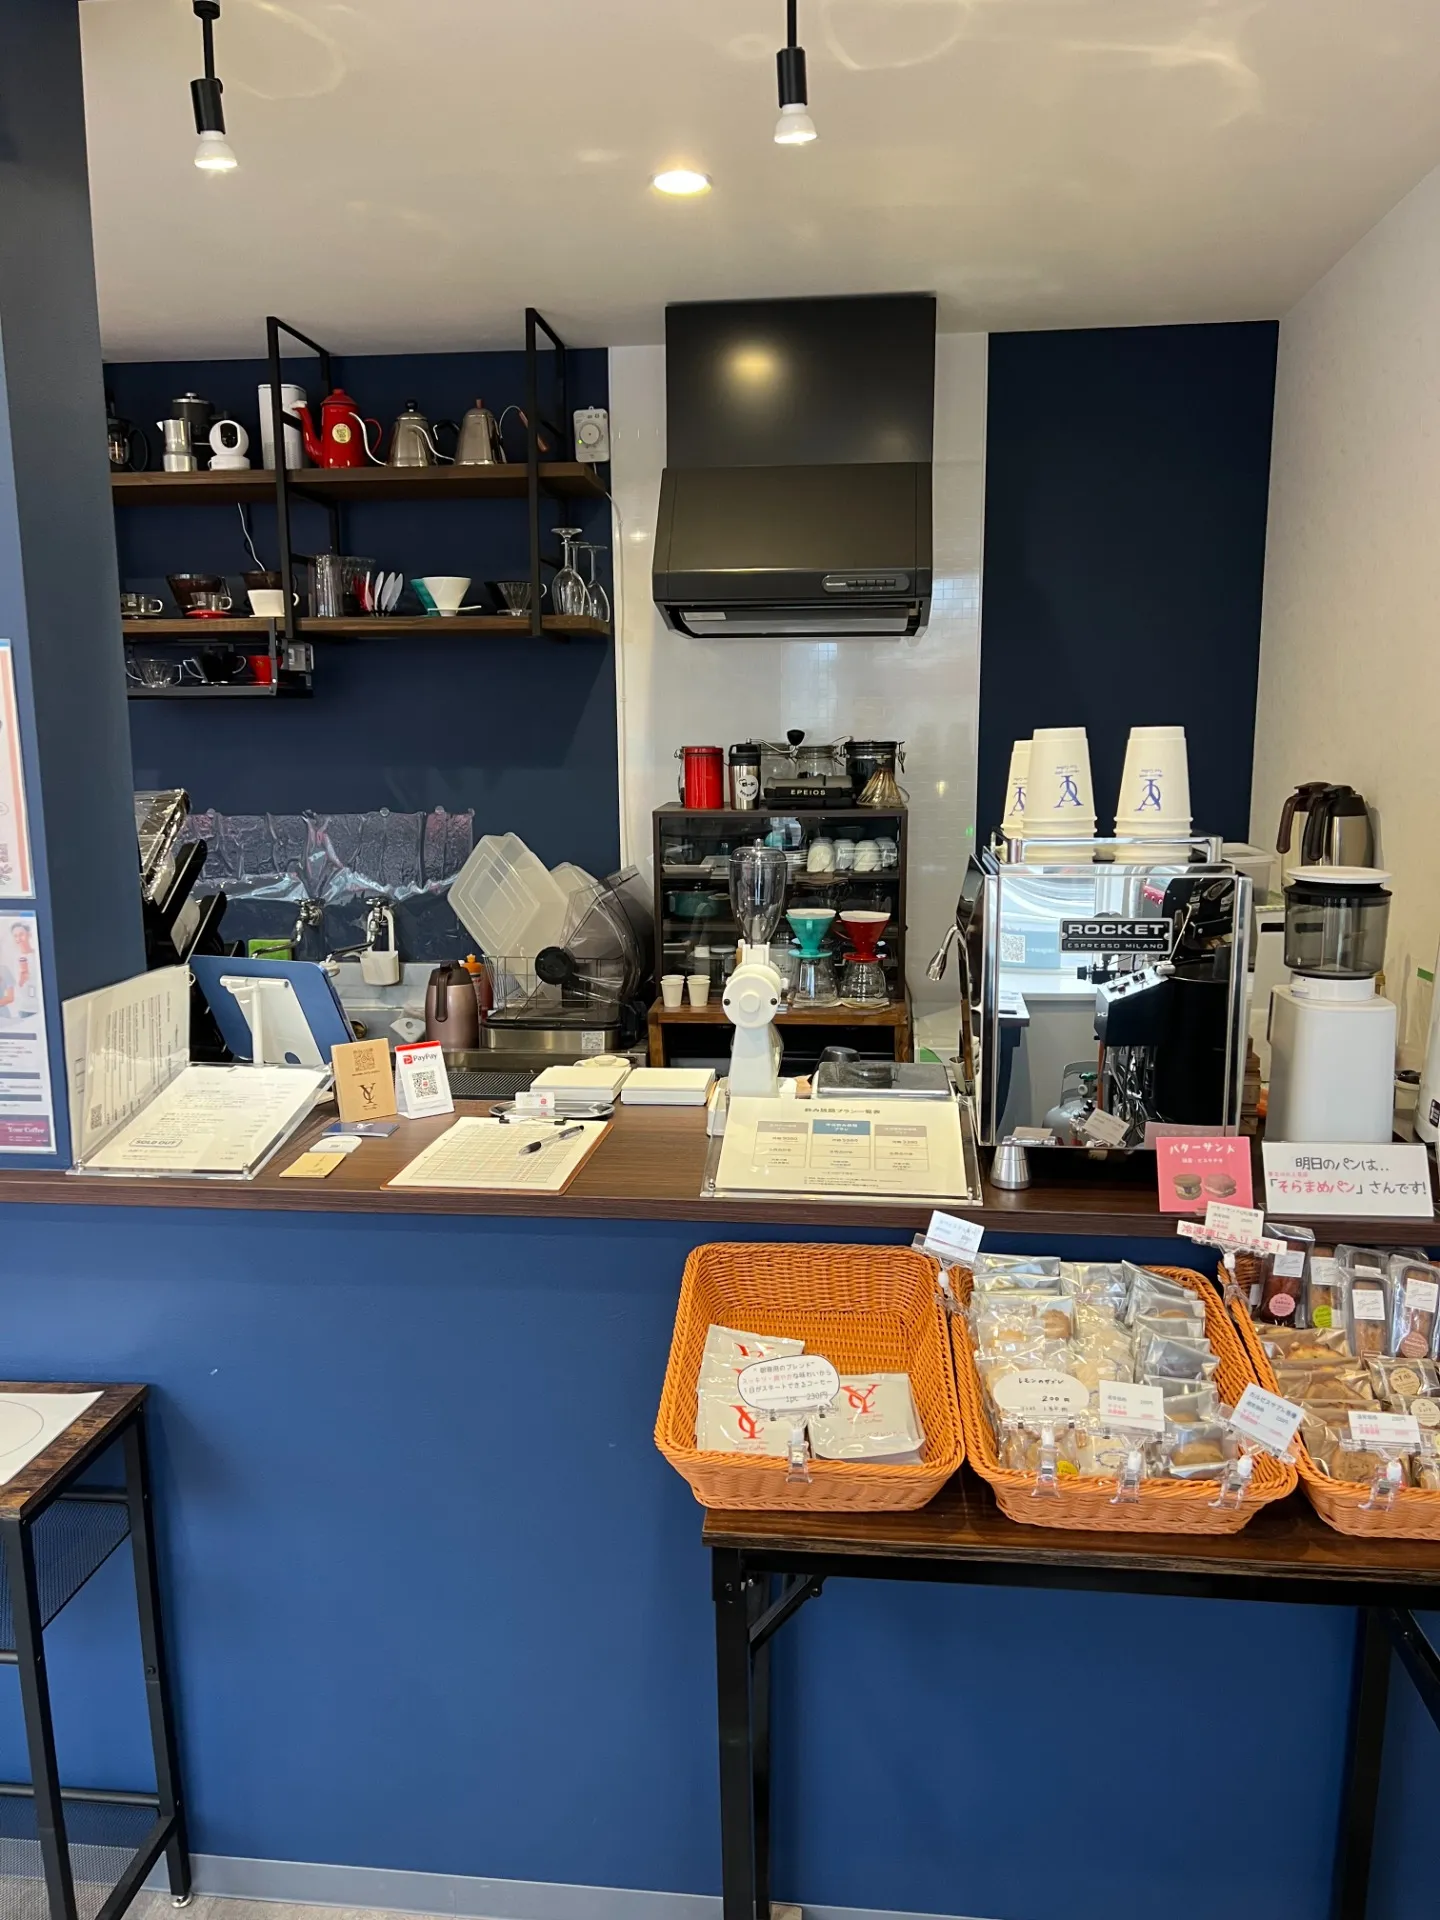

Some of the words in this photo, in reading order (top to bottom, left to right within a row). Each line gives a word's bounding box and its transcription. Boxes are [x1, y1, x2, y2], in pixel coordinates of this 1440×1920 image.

[1068, 924, 1164, 935] ROCKET
[413, 1052, 438, 1062] PayPay
[1169, 1142, 1236, 1155] バターサンド
